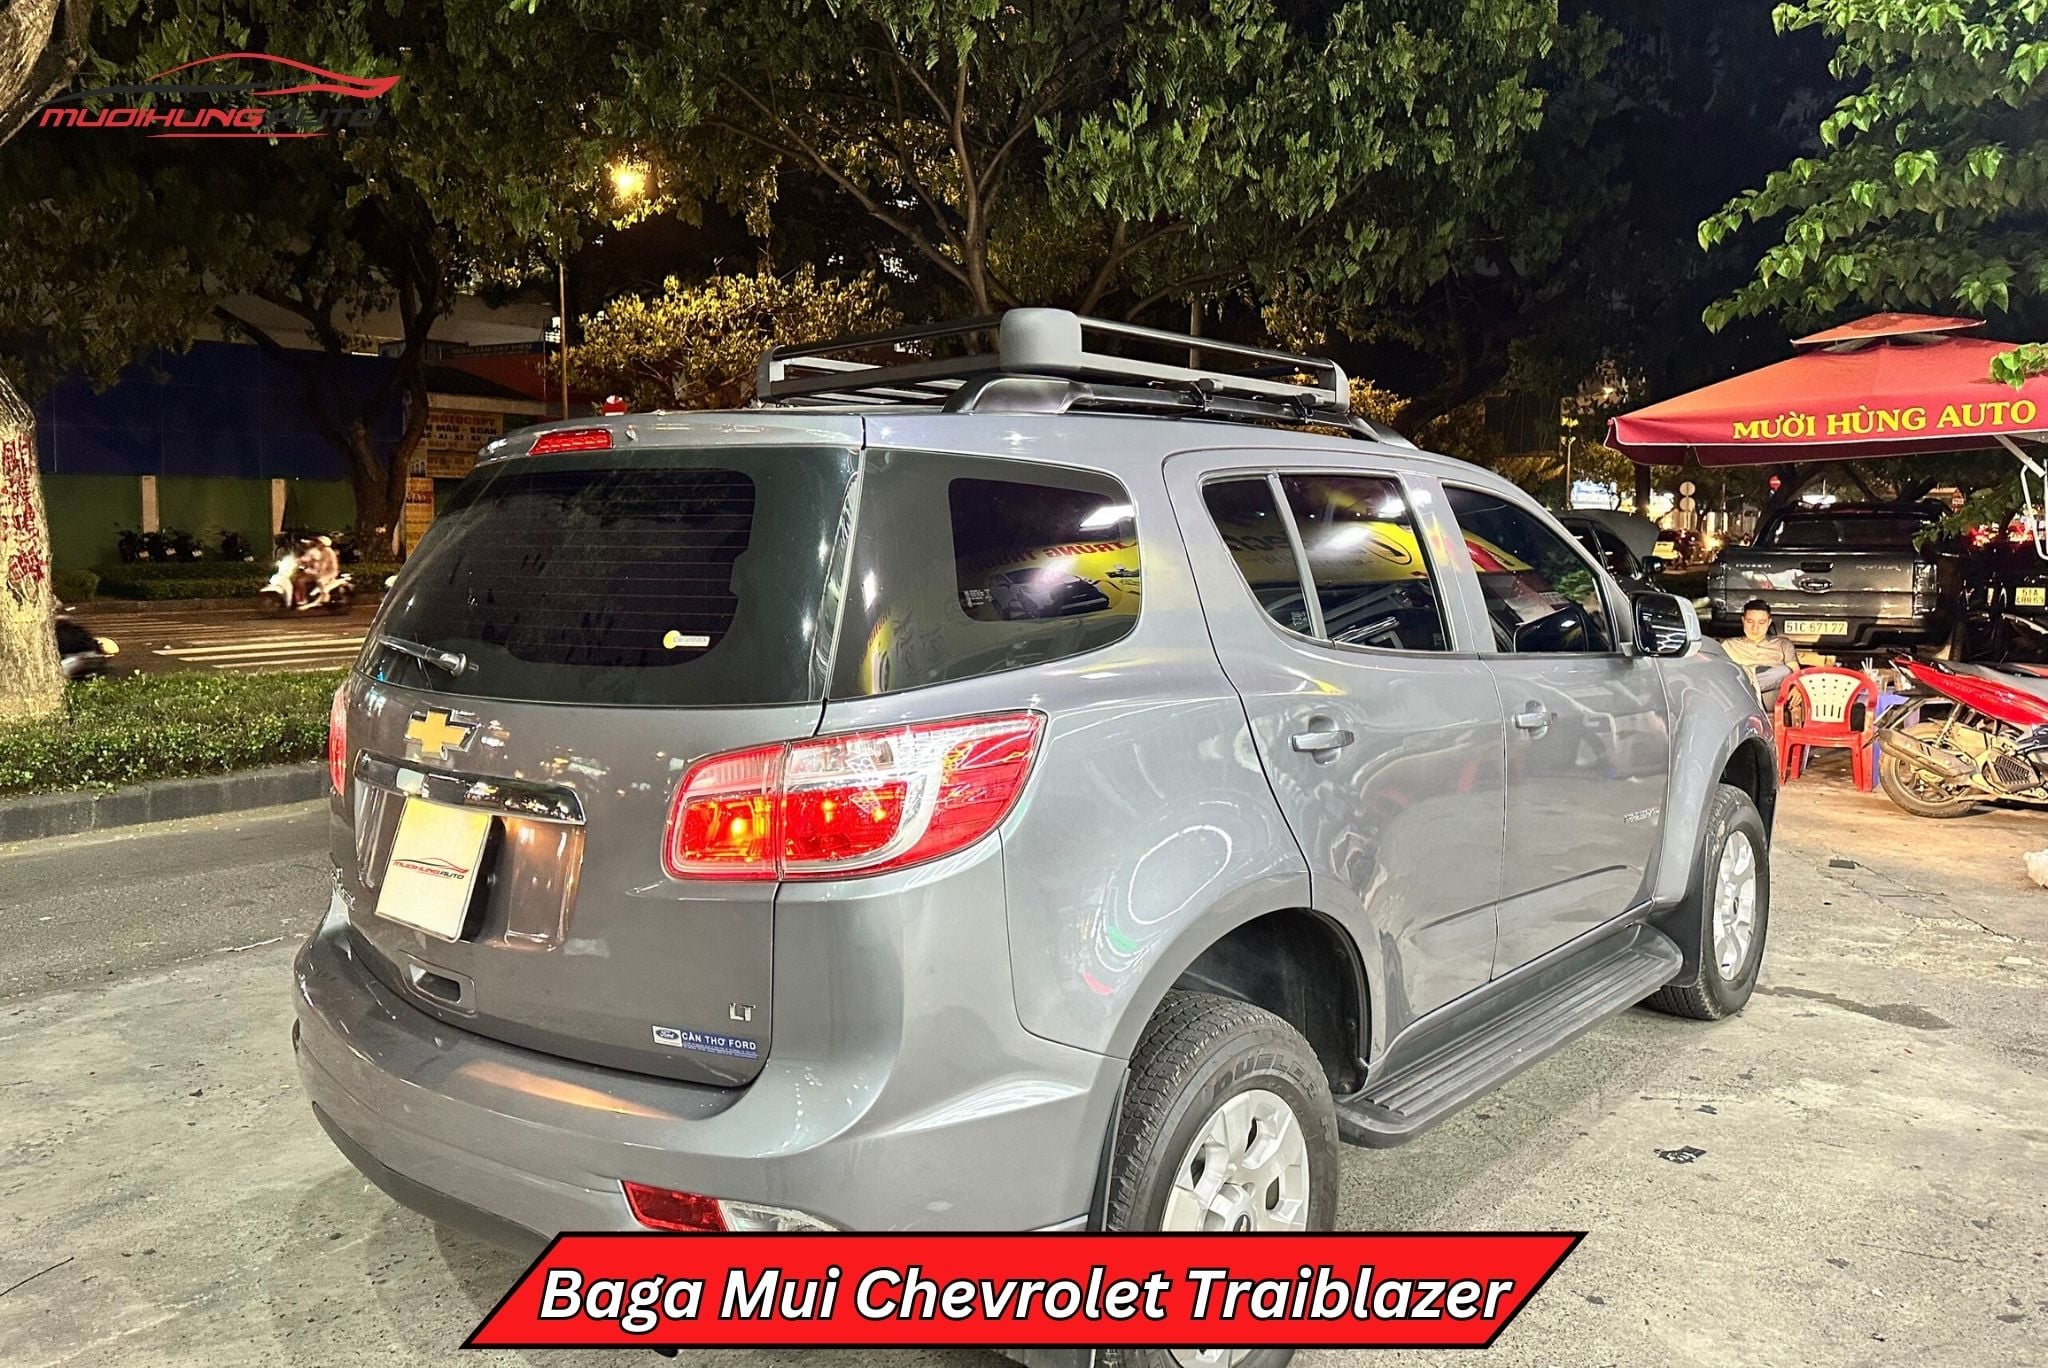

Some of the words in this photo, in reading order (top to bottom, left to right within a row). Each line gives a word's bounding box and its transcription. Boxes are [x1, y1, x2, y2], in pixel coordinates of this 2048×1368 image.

[1733, 410, 1816, 439] MƯỜI
[1826, 405, 1927, 435] HÙNG
[1936, 399, 2037, 429] AUTO
[729, 1002, 756, 1022] LT
[660, 1029, 675, 1040] Ford
[705, 1035, 726, 1046] THƠ
[729, 1039, 756, 1051] FORD
